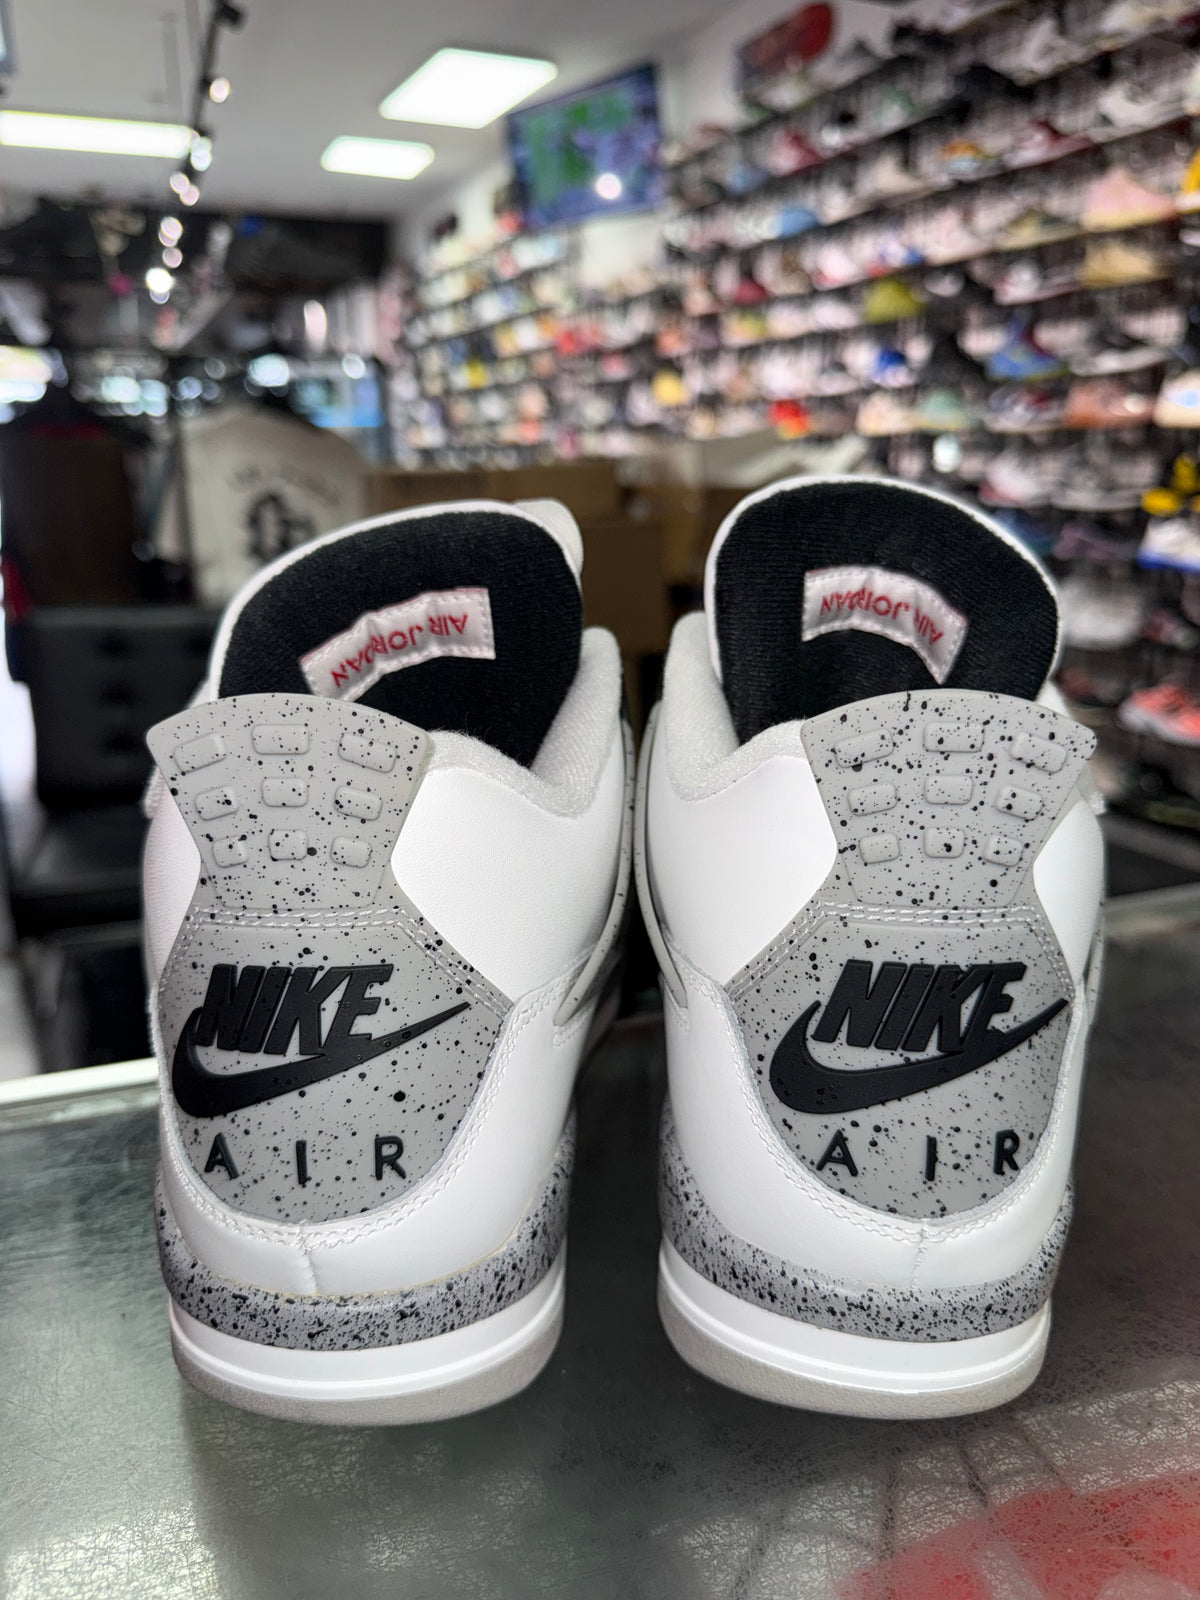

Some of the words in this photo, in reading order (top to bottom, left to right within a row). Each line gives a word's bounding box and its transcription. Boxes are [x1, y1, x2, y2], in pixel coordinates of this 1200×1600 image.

[428, 613, 468, 637] AIR
[913, 609, 943, 645] AIR
[331, 624, 423, 688] JORDAN
[191, 963, 394, 1056] NIKE
[812, 958, 1027, 1052] NIKE
[204, 1132, 406, 1185] AIR
[816, 1129, 1019, 1181] AIR
